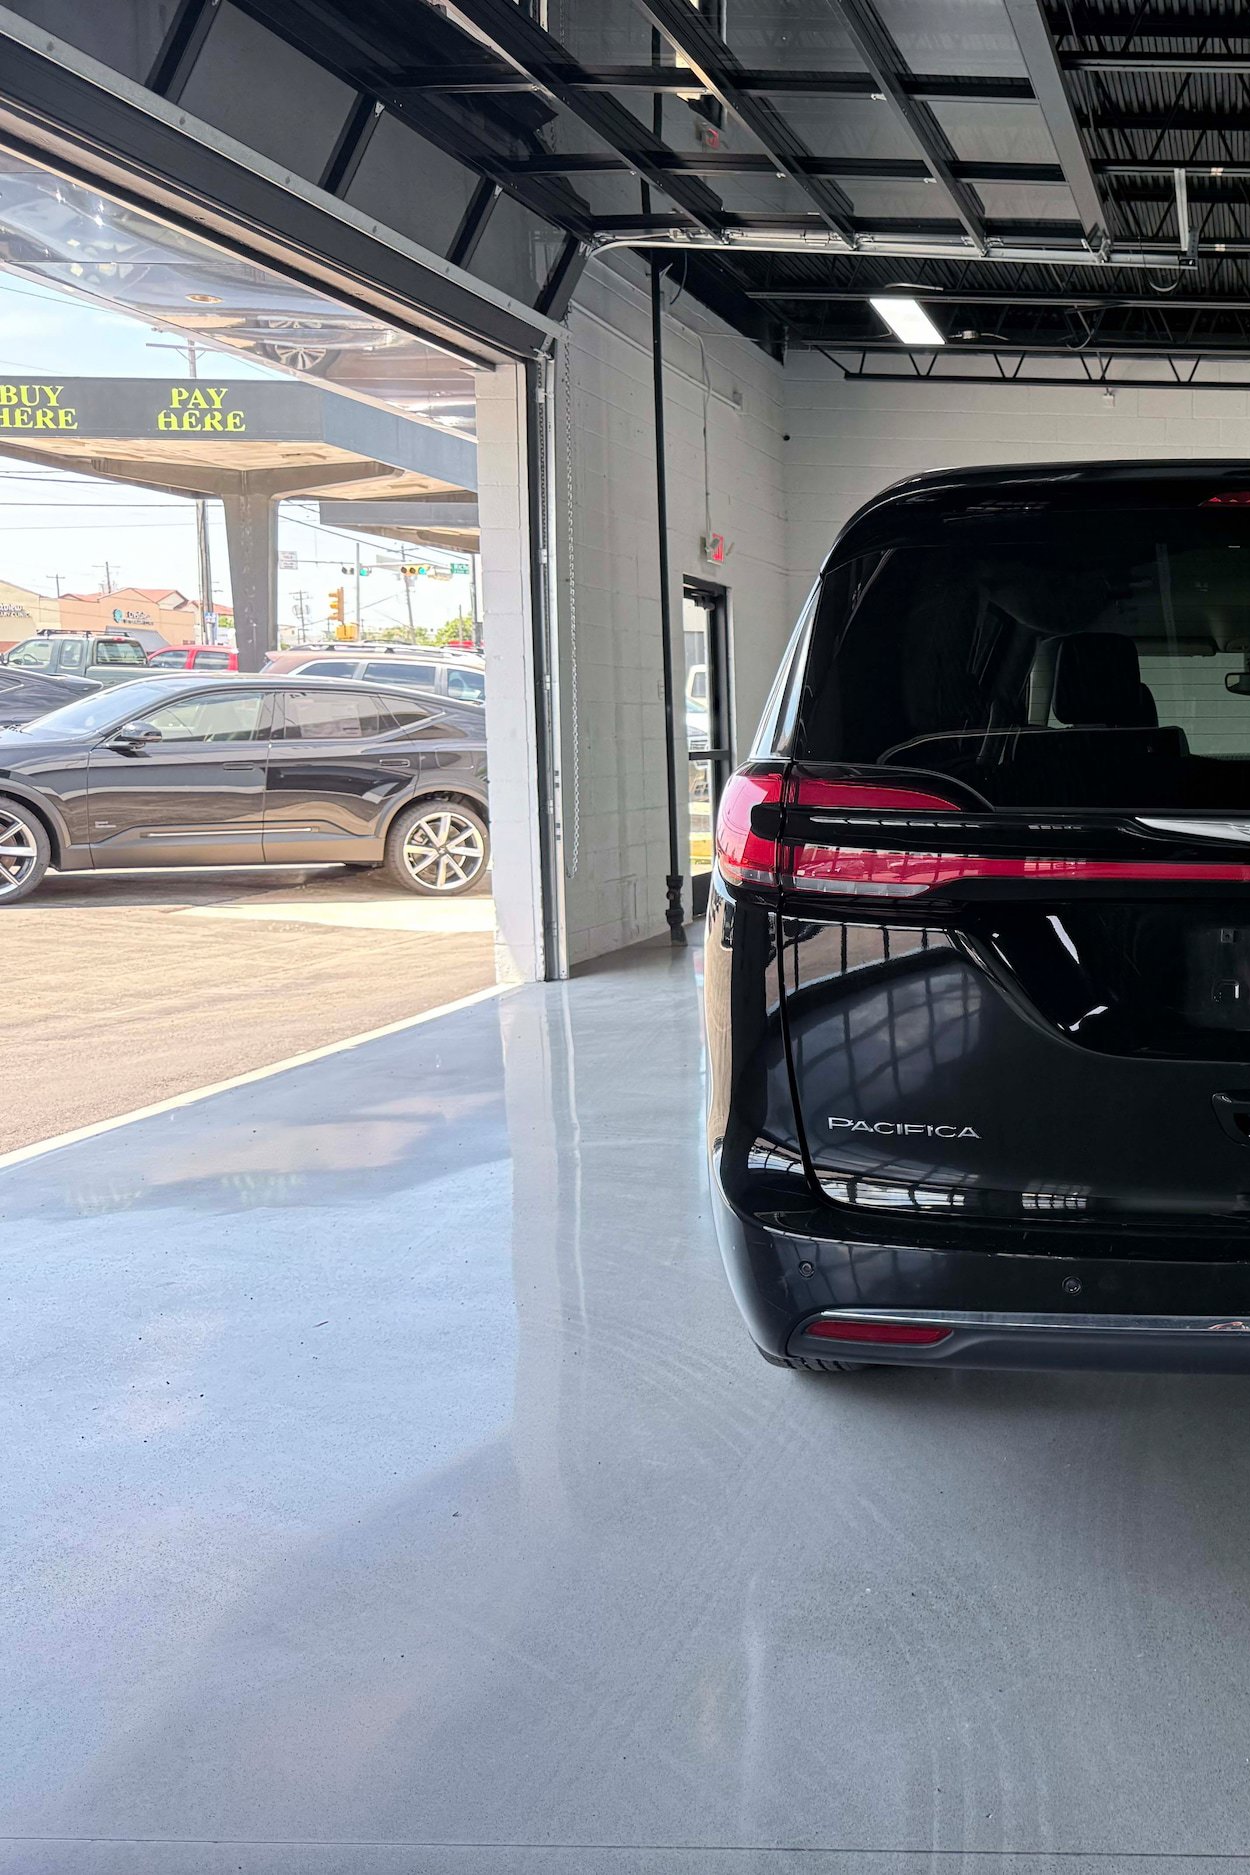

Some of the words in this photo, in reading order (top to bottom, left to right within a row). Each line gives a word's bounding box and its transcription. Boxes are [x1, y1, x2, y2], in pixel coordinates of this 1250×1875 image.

[0, 385, 64, 406] BUY
[169, 387, 228, 408] PAY
[0, 407, 78, 429] HERE
[157, 410, 246, 432] HERE
[828, 1116, 982, 1139] PACIFICA
